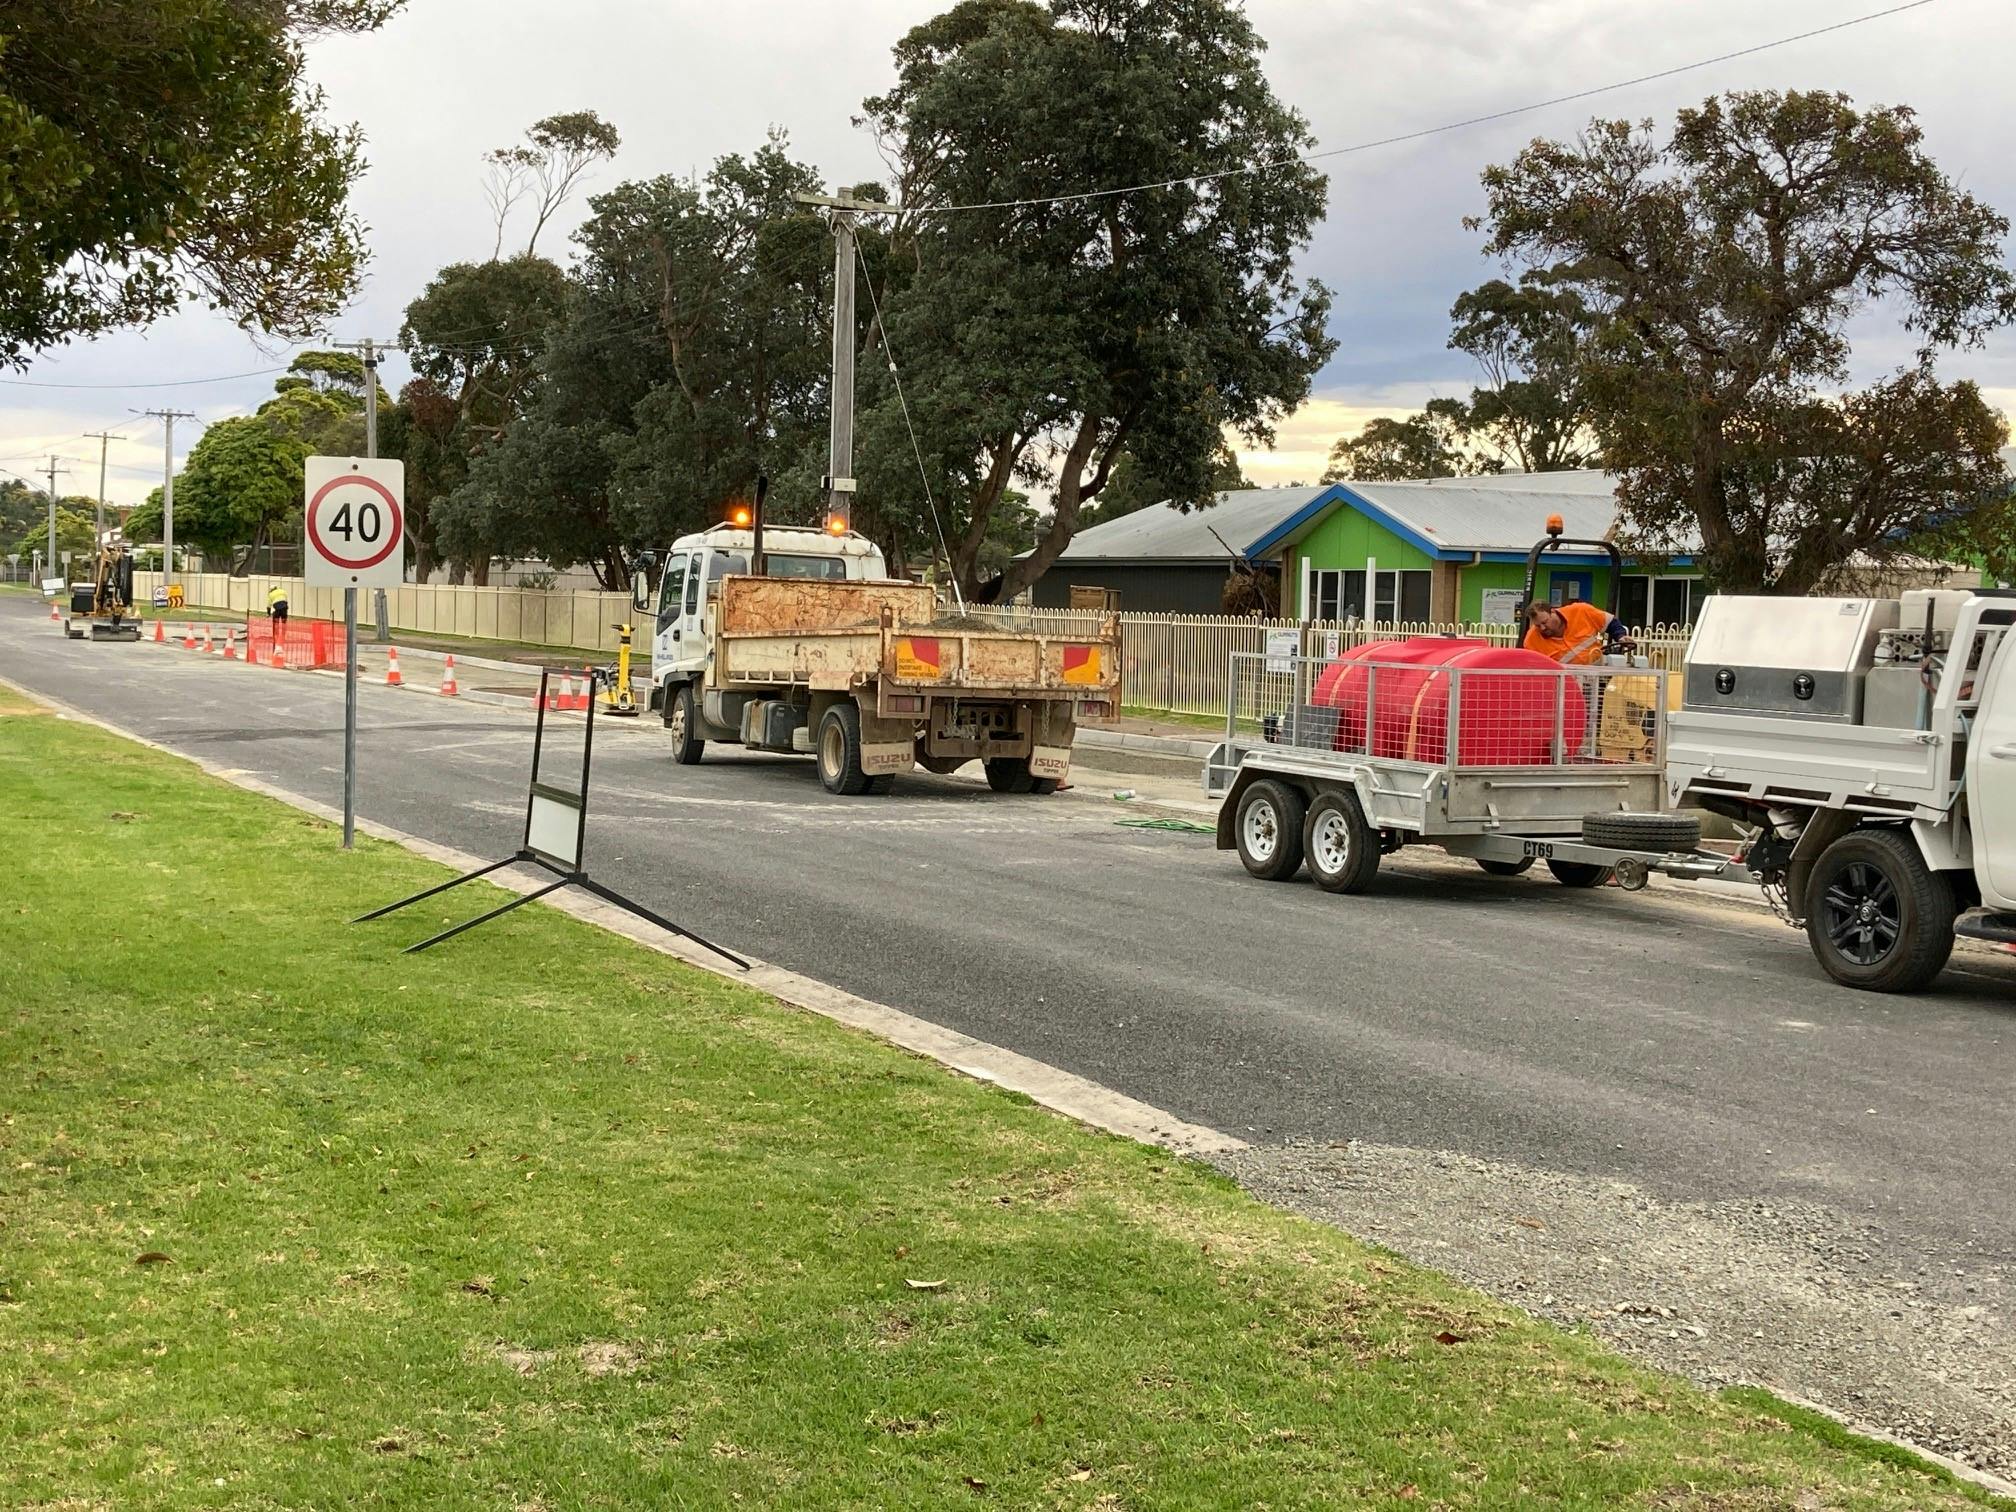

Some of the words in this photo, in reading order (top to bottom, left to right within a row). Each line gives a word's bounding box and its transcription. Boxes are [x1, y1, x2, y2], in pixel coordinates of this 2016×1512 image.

[328, 503, 380, 542] 40
[866, 753, 911, 766] ISUZU
[1034, 758, 1067, 769] ISUZU
[1524, 840, 1553, 858] CT69
